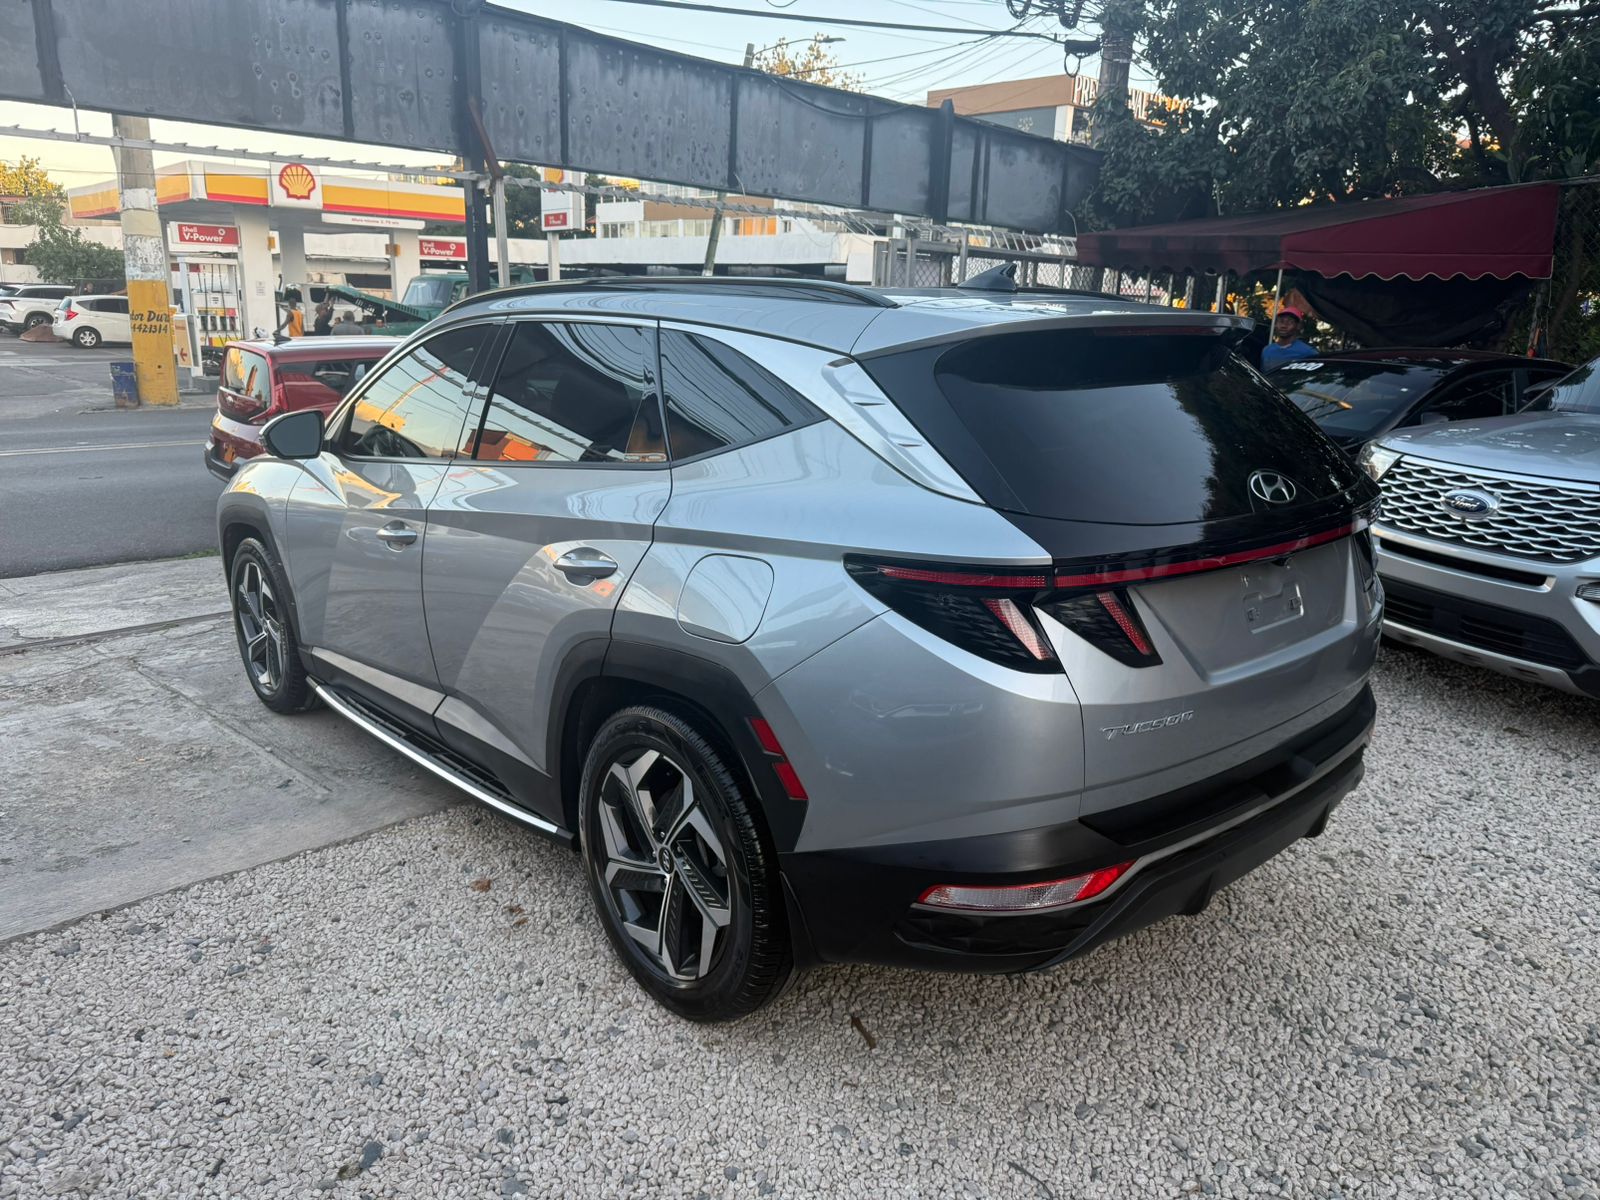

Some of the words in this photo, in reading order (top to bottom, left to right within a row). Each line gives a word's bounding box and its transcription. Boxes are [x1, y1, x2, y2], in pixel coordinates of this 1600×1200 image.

[183, 233, 224, 243] V-Power
[422, 247, 455, 256] V-Power
[1450, 495, 1480, 510] Ford
[1100, 709, 1194, 741] TUCSON
